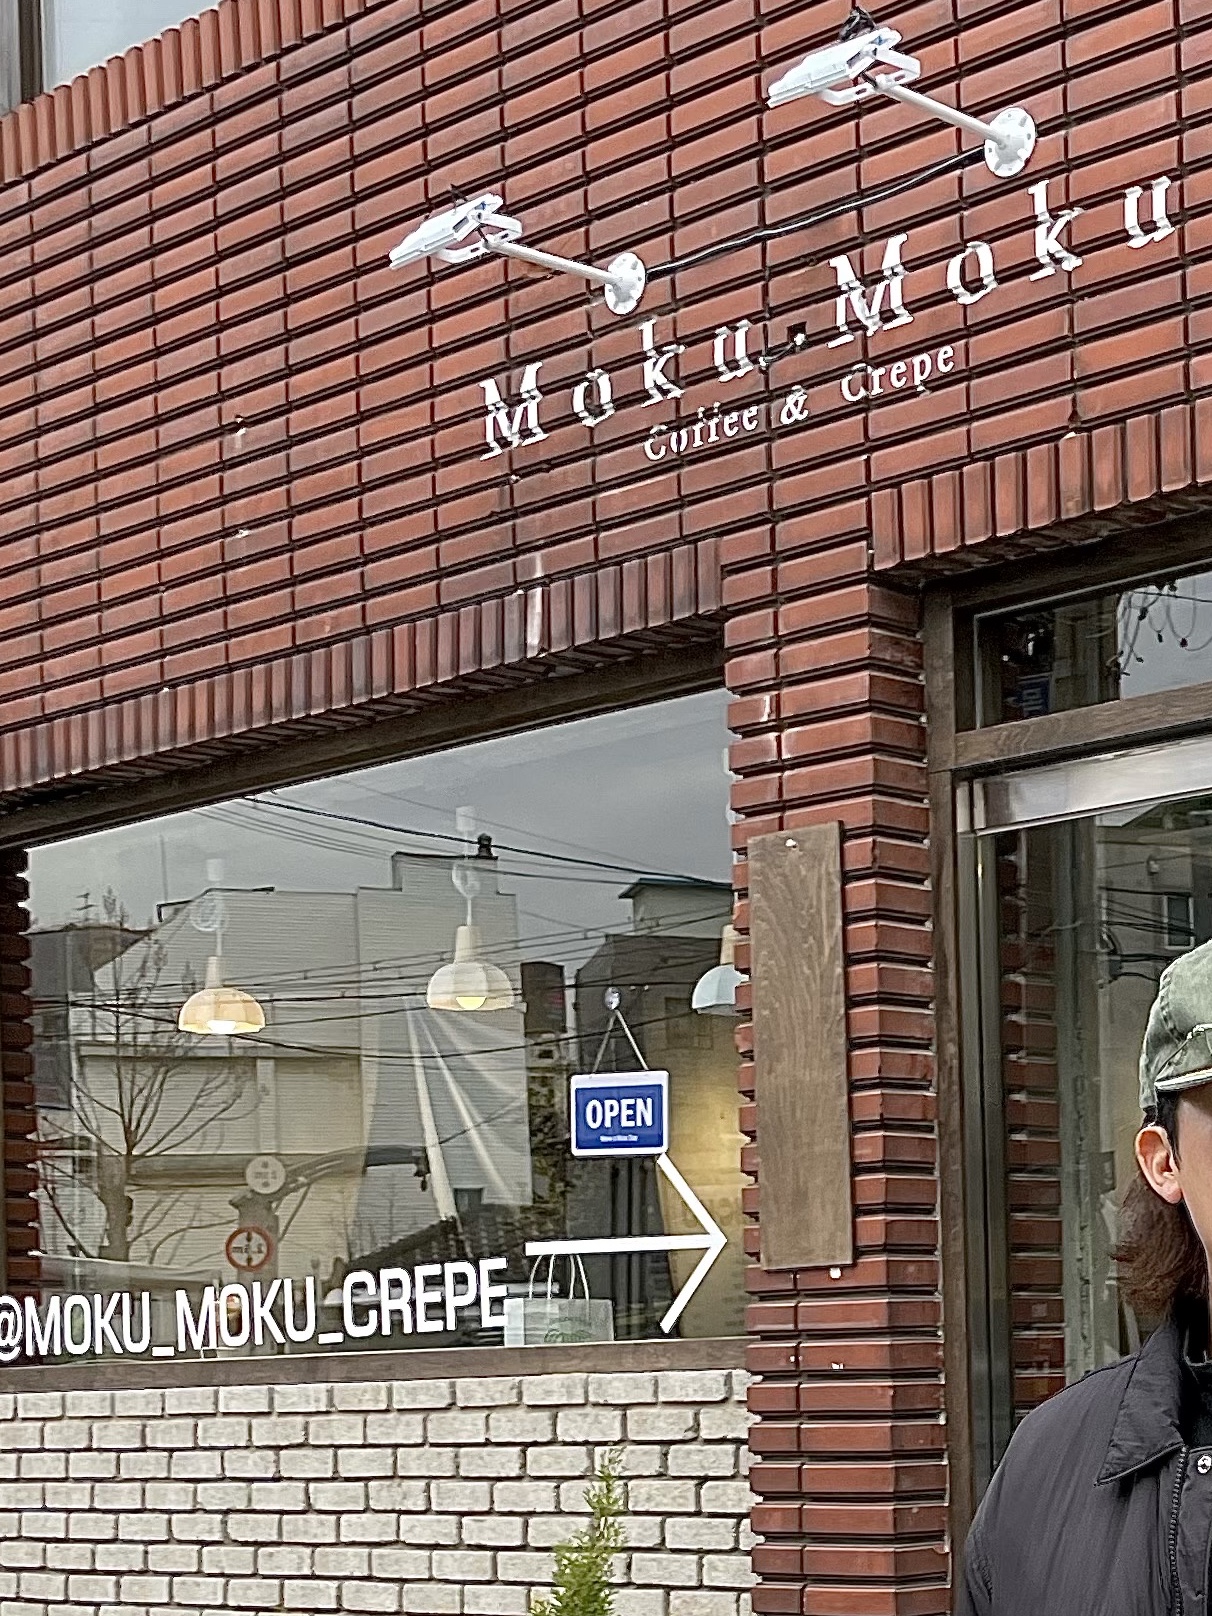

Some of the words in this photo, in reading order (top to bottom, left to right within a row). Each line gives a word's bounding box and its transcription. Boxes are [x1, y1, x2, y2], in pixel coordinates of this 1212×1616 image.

[480, 318, 754, 461] Moku
[827, 177, 1181, 348] Moku
[643, 401, 759, 462] Coffee
[780, 385, 810, 425] &
[841, 344, 956, 402] Crepe
[585, 1097, 653, 1129] OPEN
[0, 1257, 509, 1363] @MOKU_MOKU_CREPE
